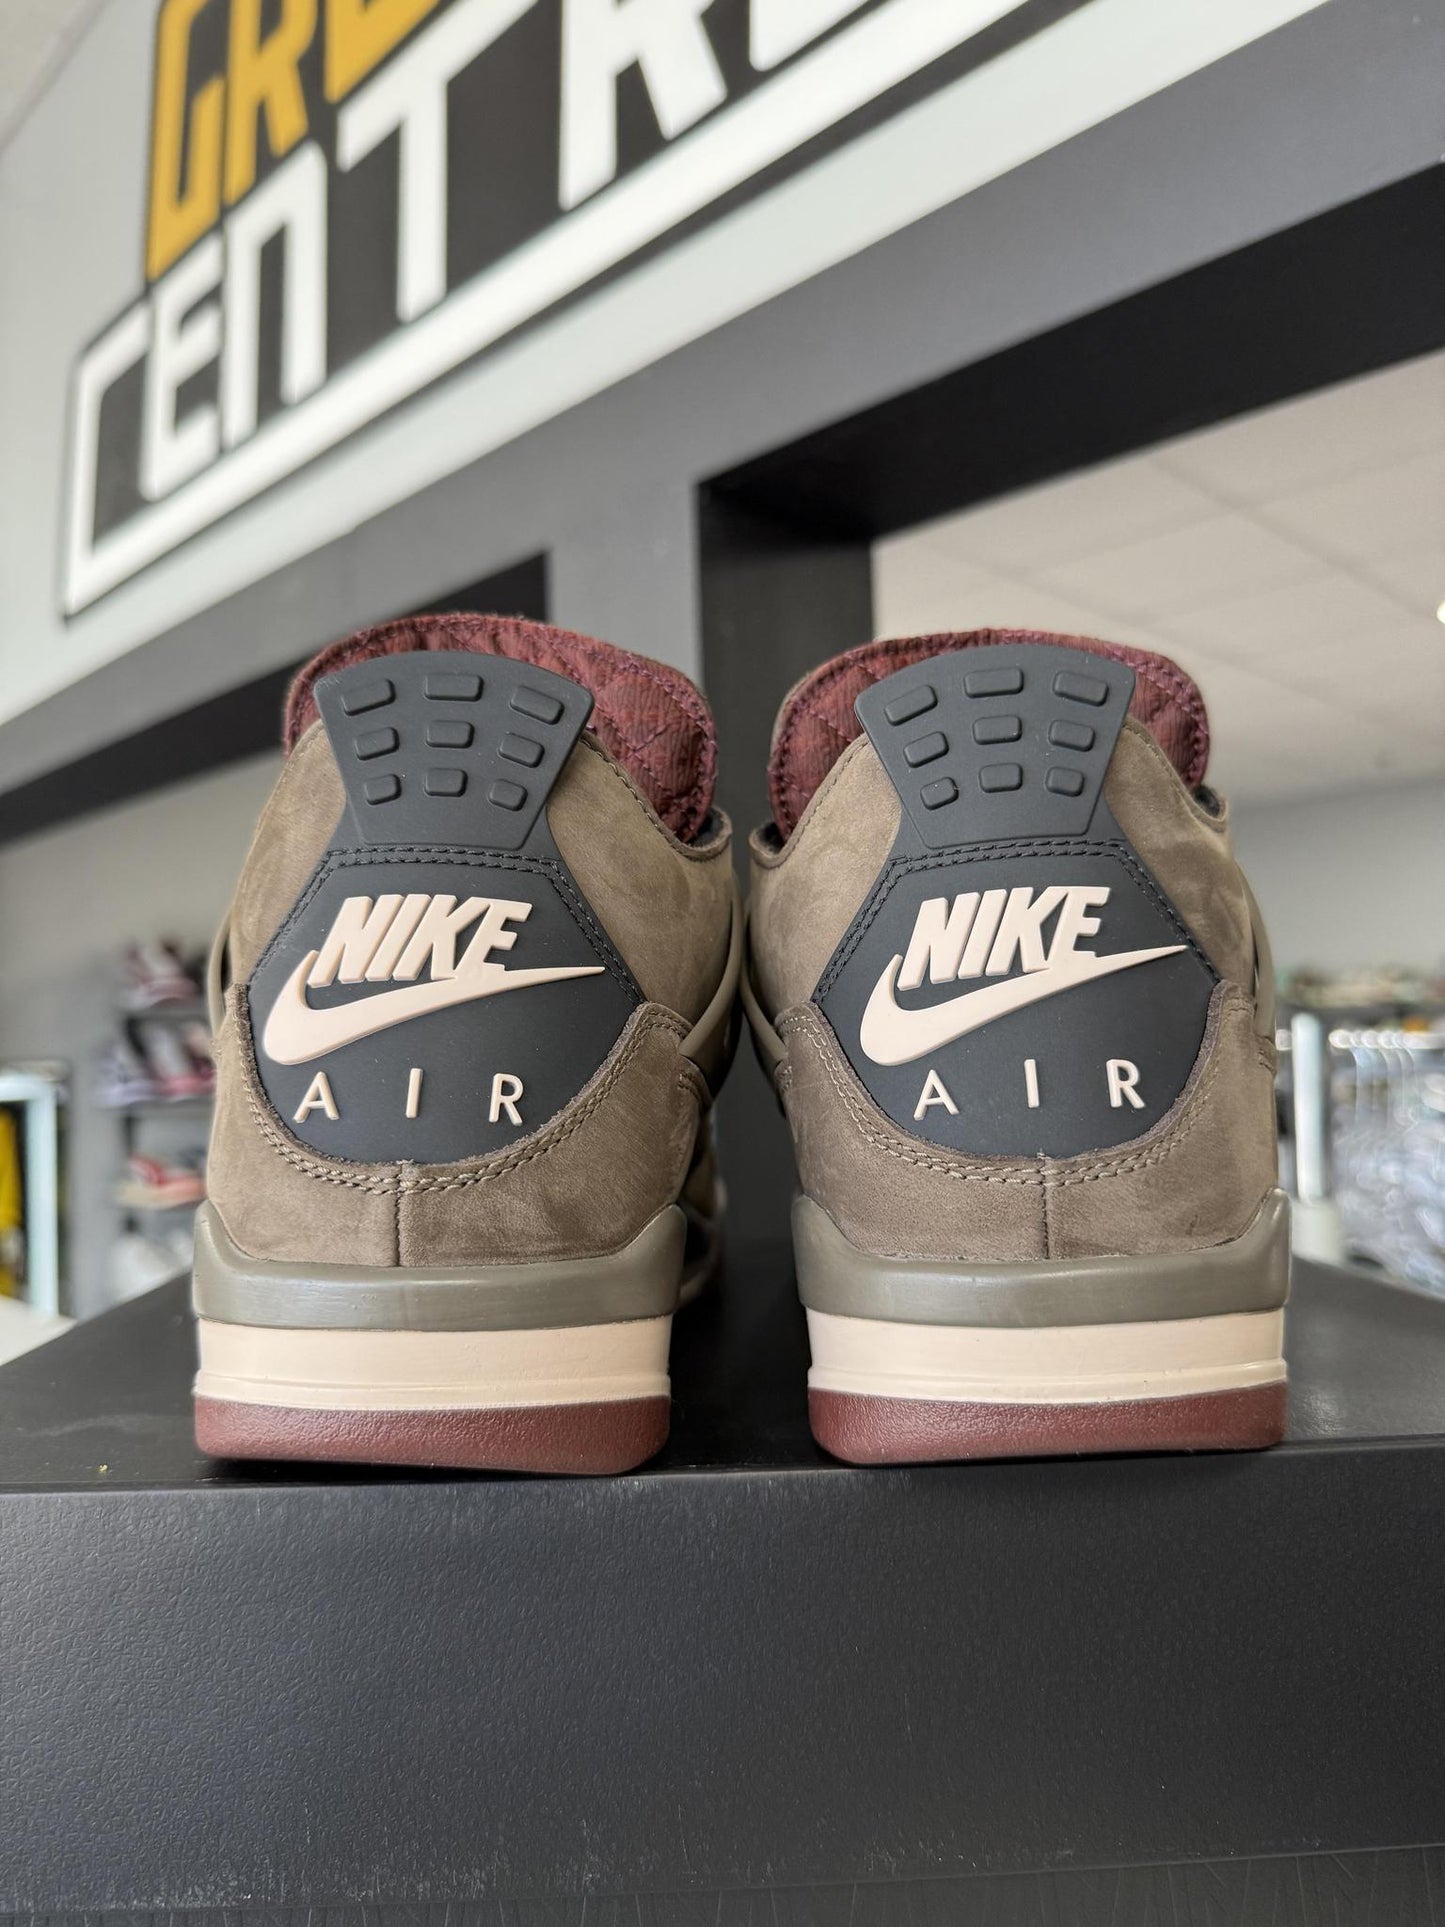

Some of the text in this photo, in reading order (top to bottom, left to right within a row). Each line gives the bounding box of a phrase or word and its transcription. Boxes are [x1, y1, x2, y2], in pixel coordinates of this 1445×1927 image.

[66, 0, 880, 616] CENTR
[307, 893, 533, 989] NIKE
[897, 885, 1111, 991] NIKE
[292, 1067, 524, 1126] AIR
[913, 1058, 1146, 1121] AIR
